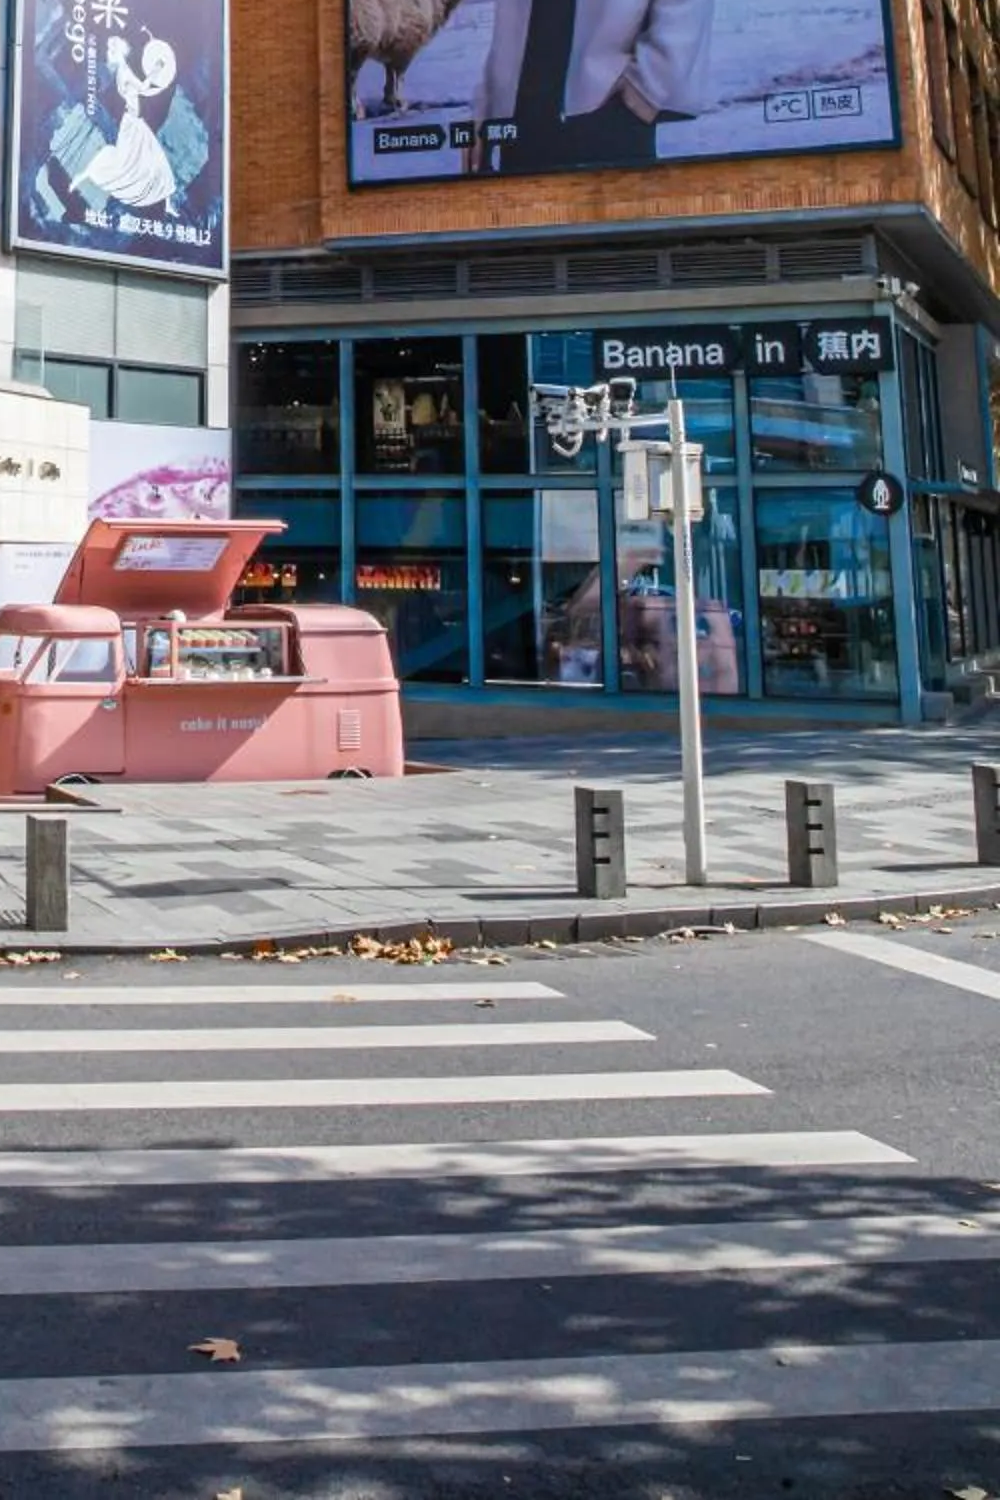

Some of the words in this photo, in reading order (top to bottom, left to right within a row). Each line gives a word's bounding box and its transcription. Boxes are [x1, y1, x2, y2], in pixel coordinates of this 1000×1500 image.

[378, 133, 438, 149] Banana
[455, 128, 470, 143] in
[602, 340, 725, 369] Banana
[755, 334, 785, 364] in
[817, 329, 881, 361] 蕉内
